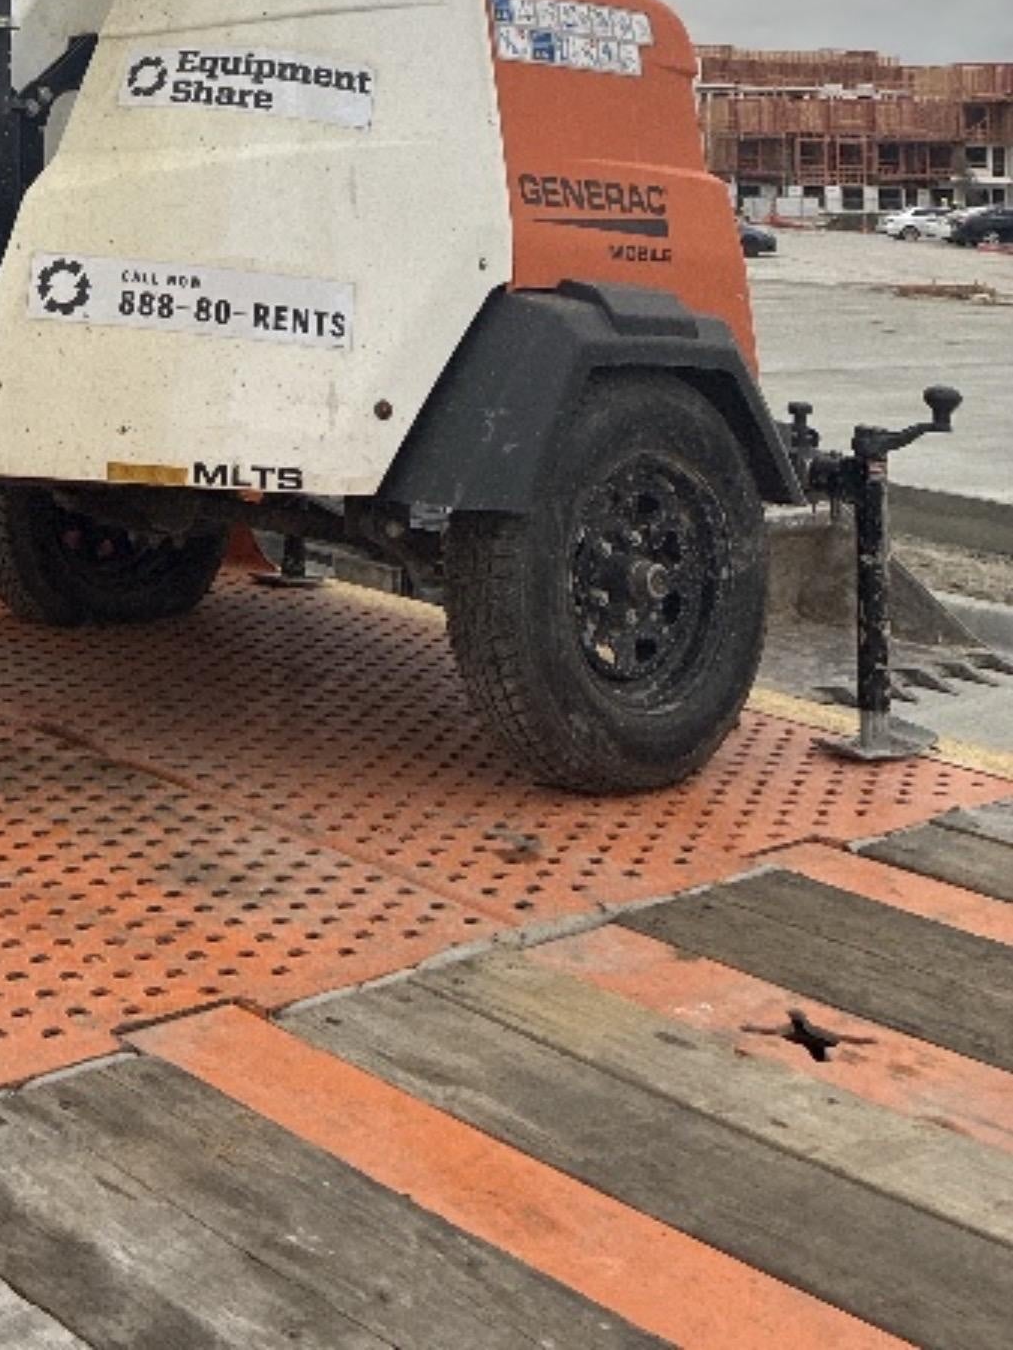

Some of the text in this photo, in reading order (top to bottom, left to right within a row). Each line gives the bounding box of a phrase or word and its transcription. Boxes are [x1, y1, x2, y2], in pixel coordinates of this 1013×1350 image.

[176, 50, 371, 94] Equipment
[170, 80, 273, 109] Share
[518, 173, 666, 216] GENERAC
[121, 269, 158, 285] CALL
[119, 290, 346, 338] 888-80-RENTS
[193, 462, 303, 489] MLTS
